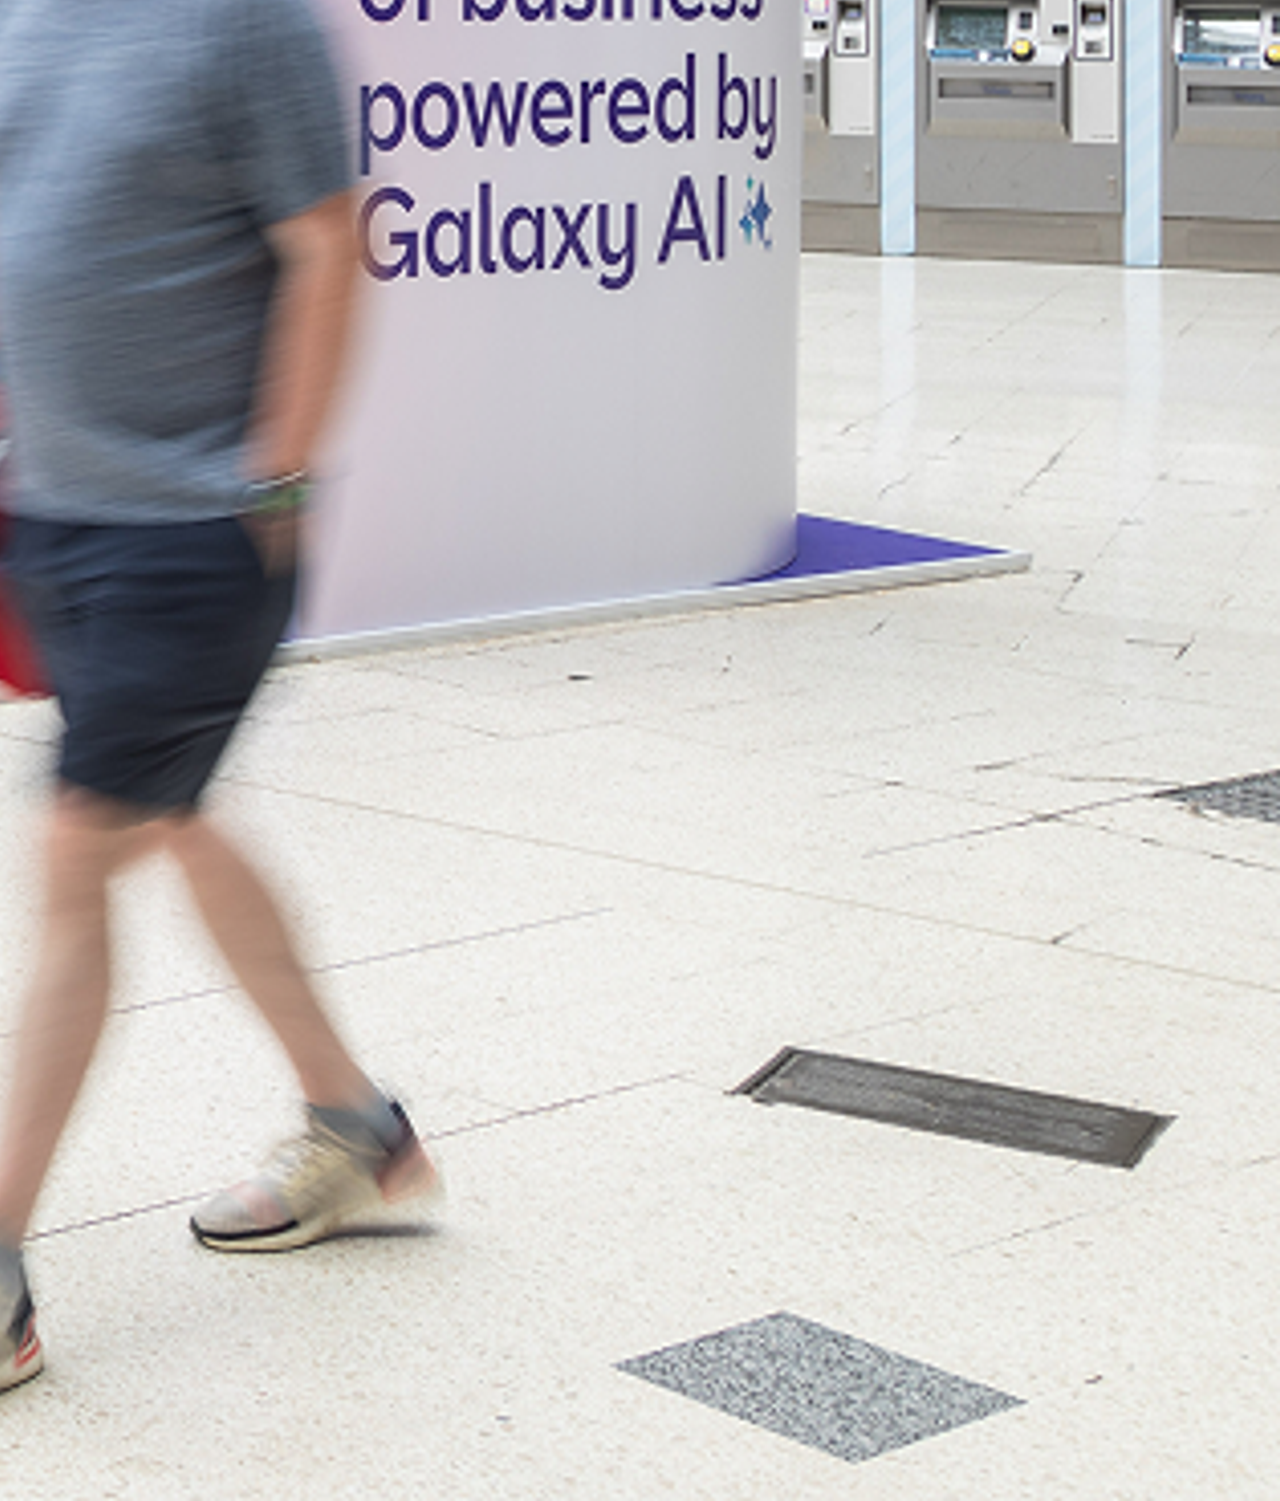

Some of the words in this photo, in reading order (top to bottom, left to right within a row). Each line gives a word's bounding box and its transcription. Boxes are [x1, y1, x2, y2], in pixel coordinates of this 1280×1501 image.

[359, 53, 696, 176] powered
[717, 53, 777, 160] by
[358, 182, 636, 290] Galaxy
[658, 174, 728, 264] AI
